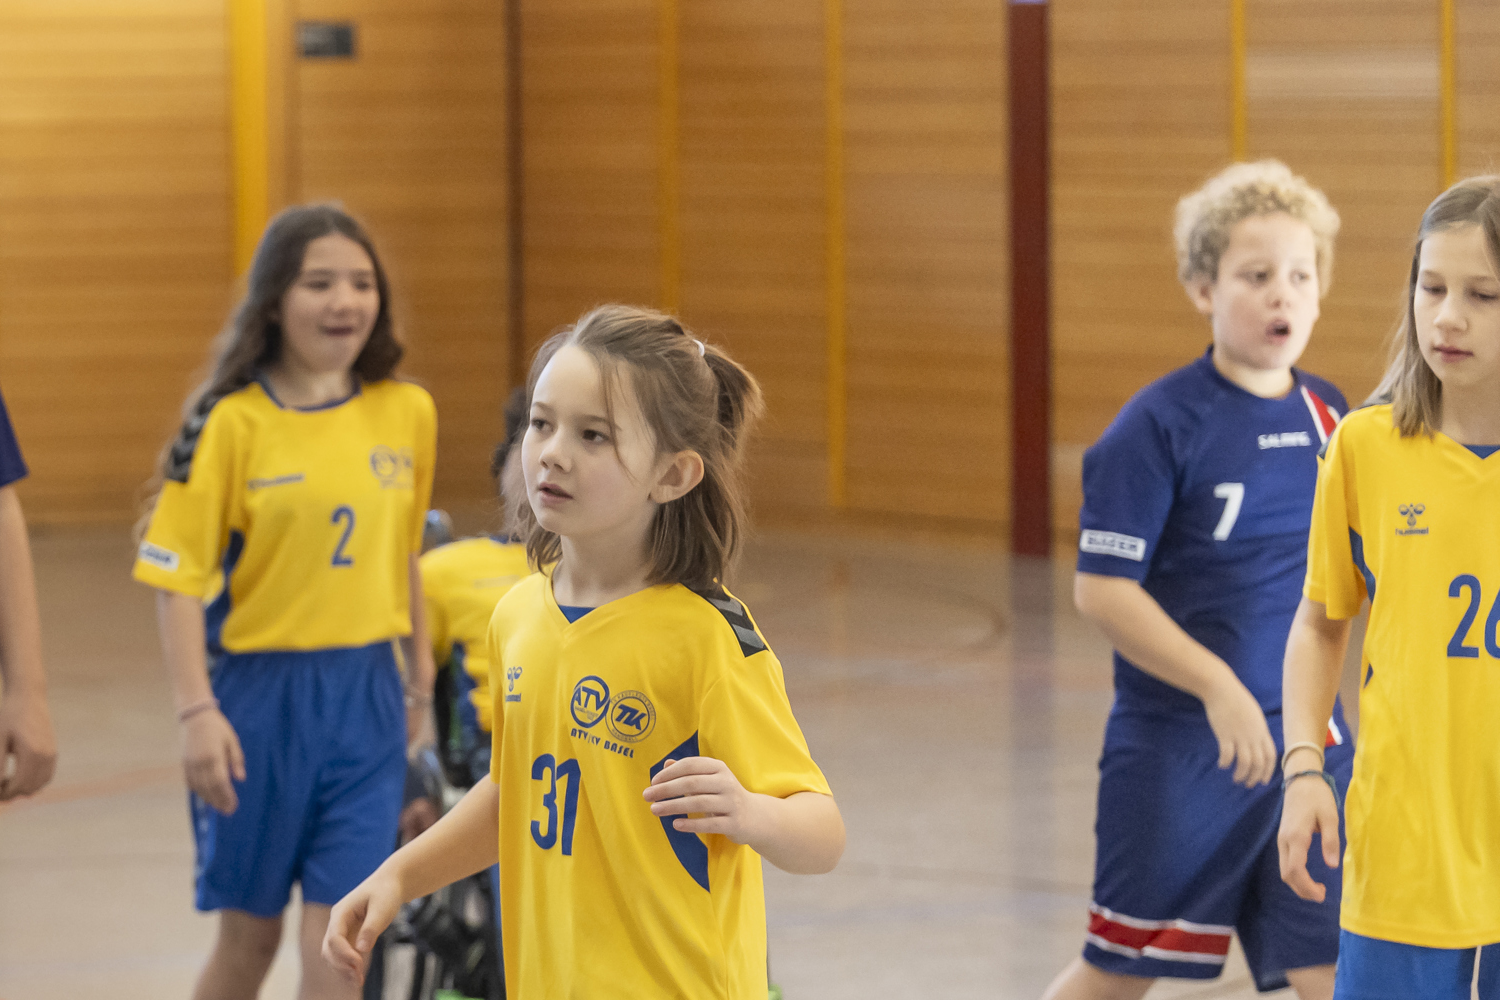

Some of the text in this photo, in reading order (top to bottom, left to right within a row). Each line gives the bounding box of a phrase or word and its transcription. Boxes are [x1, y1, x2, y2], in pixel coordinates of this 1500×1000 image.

[331, 504, 356, 568] 2
[1213, 482, 1245, 541] 7
[574, 686, 601, 711] ATV
[604, 740, 634, 758] BASEL
[530, 753, 582, 856] 31
